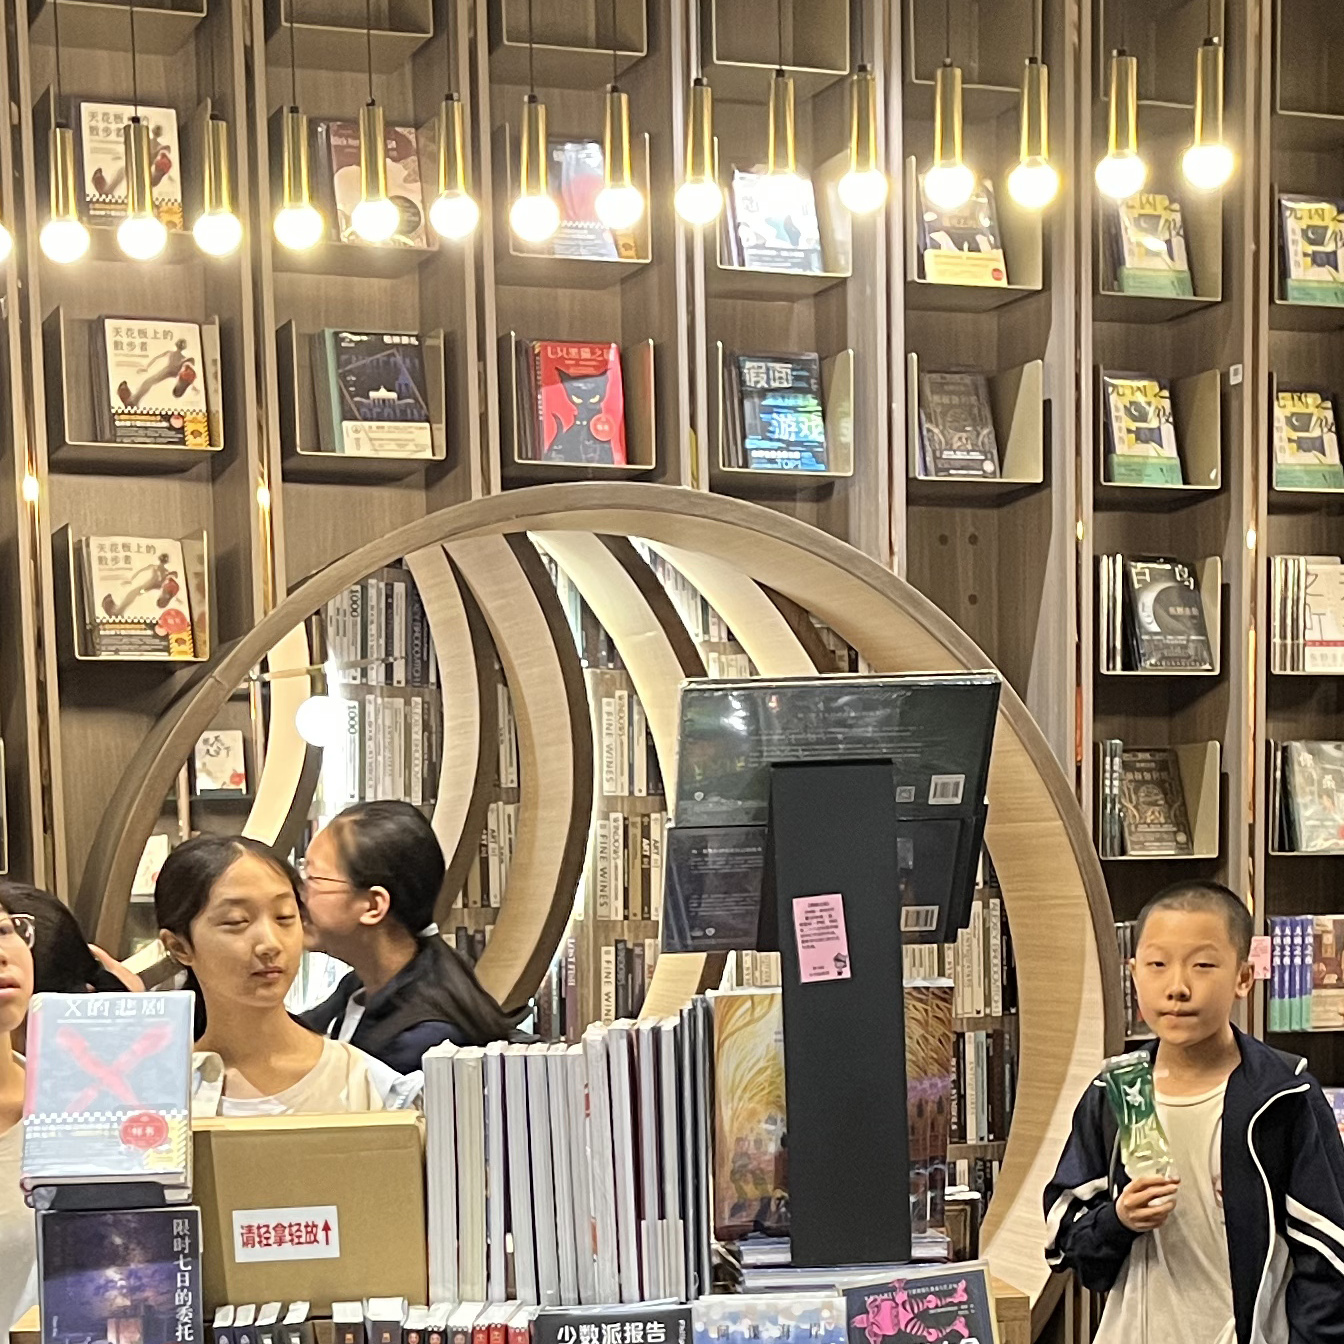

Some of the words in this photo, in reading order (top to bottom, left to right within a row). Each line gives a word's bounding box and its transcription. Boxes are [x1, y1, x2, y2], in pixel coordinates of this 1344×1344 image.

[744, 361, 793, 388] 假面
[771, 412, 824, 440] 游戏
[348, 705, 358, 735] 1000
[605, 743, 614, 783] WINES
[599, 834, 608, 862] FINE
[599, 866, 608, 908] WINES
[64, 998, 165, 1017] X的悲剧
[240, 1220, 320, 1250] 请轻拿轻放
[172, 1219, 195, 1342] 限时七日的委托
